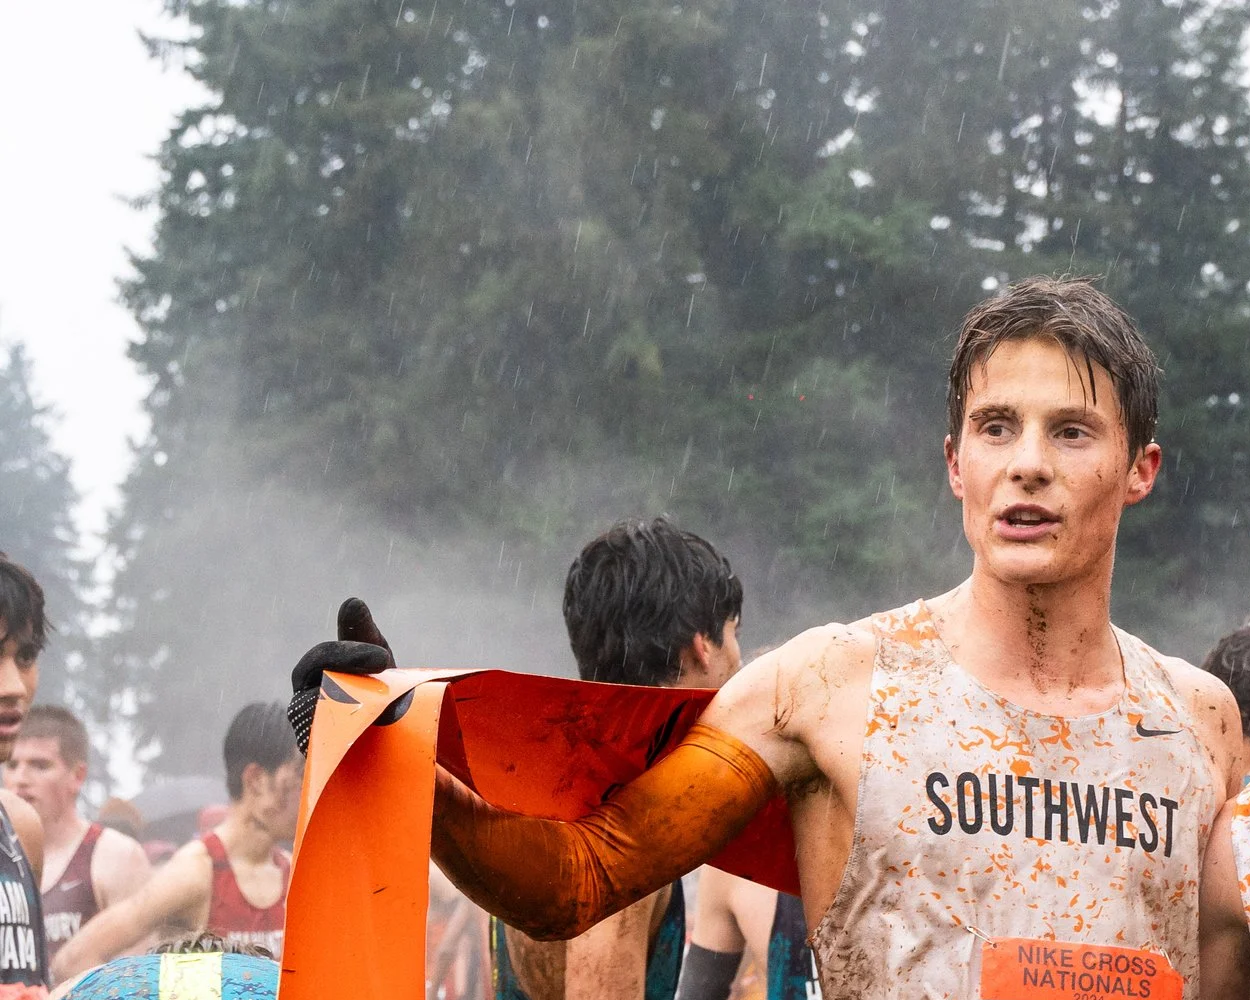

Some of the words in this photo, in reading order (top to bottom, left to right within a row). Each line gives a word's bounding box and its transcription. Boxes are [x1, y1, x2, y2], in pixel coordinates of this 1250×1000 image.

[925, 771, 1179, 858] SOUTHWEST
[1018, 945, 1074, 968] NIKE
[1082, 951, 1157, 977] CROSS
[1023, 967, 1151, 998] NATIONALS
